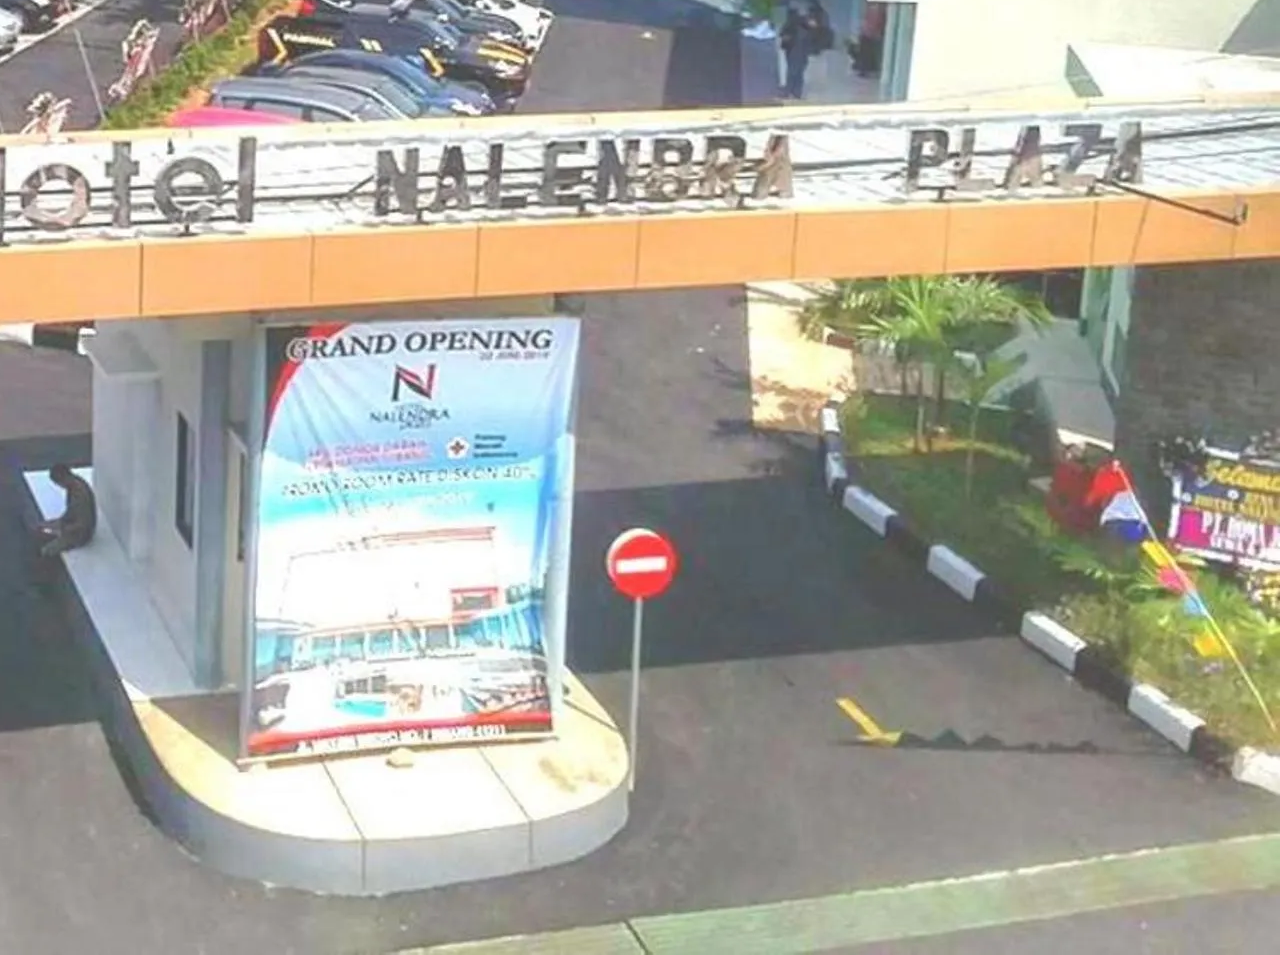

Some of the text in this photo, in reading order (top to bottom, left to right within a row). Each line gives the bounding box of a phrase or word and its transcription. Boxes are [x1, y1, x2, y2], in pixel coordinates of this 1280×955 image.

[375, 134, 795, 217] NALENDRA
[905, 121, 1146, 191] PLAZA
[286, 329, 554, 362] GRAND OPENING
